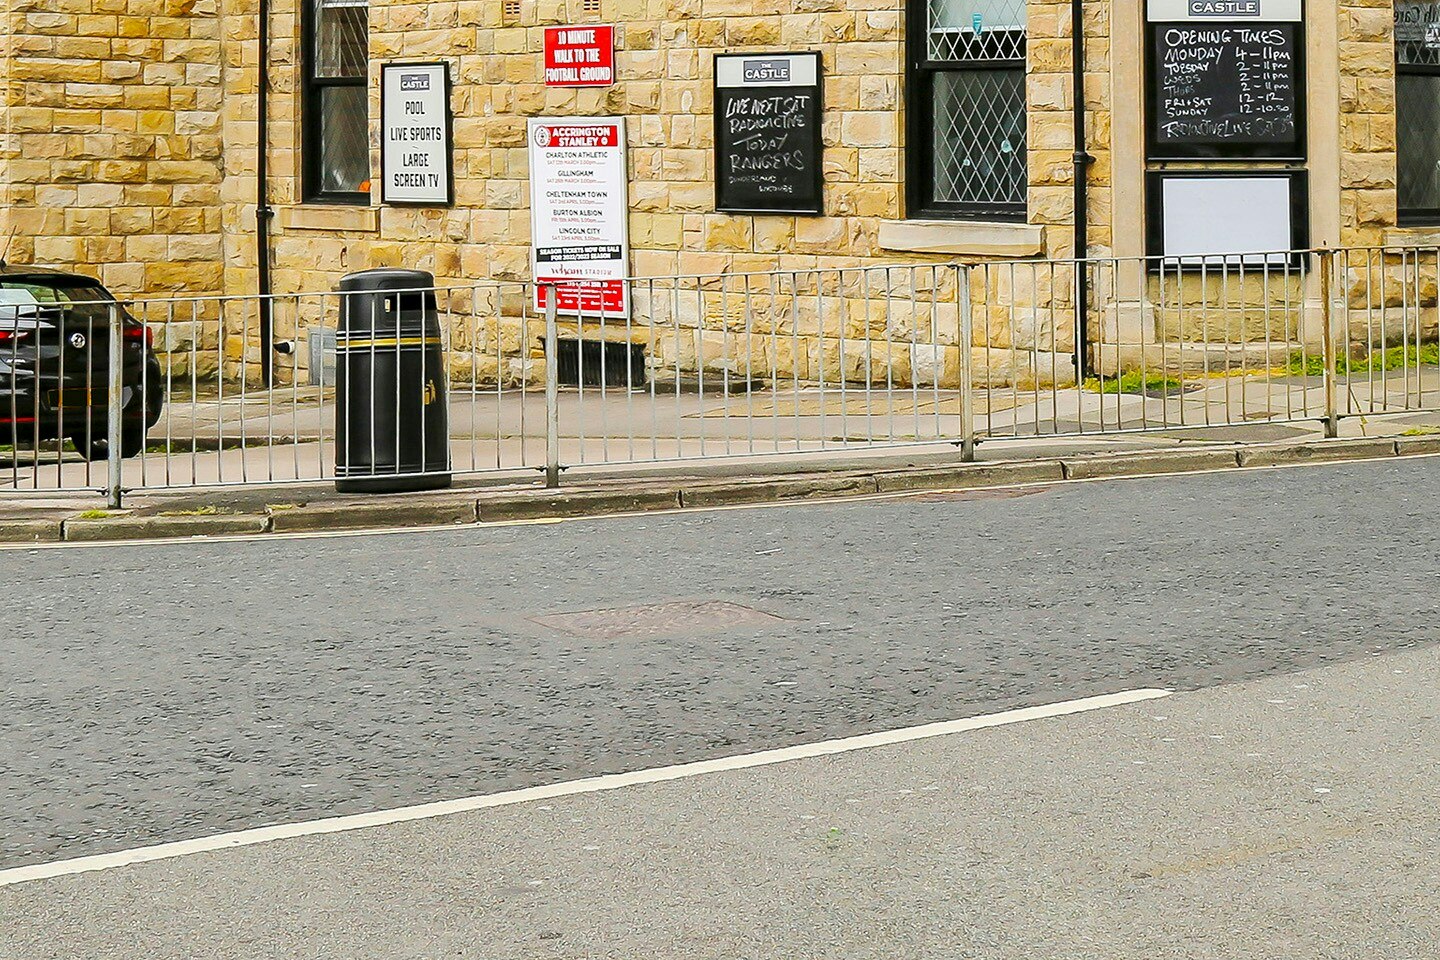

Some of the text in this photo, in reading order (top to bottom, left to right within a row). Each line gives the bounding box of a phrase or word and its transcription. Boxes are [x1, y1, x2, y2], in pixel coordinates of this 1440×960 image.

[1191, 2, 1256, 13] CASTLE
[557, 30, 596, 45] 10 MINUTE
[1165, 29, 1286, 46] OPENING TIMES
[554, 48, 600, 63] WALK TO THE
[1164, 46, 1224, 65] MONDAY
[545, 66, 611, 82] FOOTBALL GROUND
[745, 68, 788, 79] CASTLE
[1164, 62, 1210, 75] TUESDAY
[402, 81, 429, 89] CASTLE
[1163, 74, 1201, 85] WEDS
[405, 101, 425, 115] POOL
[725, 95, 810, 118] LIVE NEXT SAT
[1166, 107, 1209, 118] SUNDAY
[391, 127, 441, 141] LIVE SPORTS
[552, 127, 611, 137] ACCRINGTON
[558, 137, 600, 147] STANLEY
[732, 133, 788, 151] TODAY
[403, 153, 429, 167] LARGE
[729, 149, 805, 173] RANGERS
[394, 173, 439, 187] SCREEN TV
